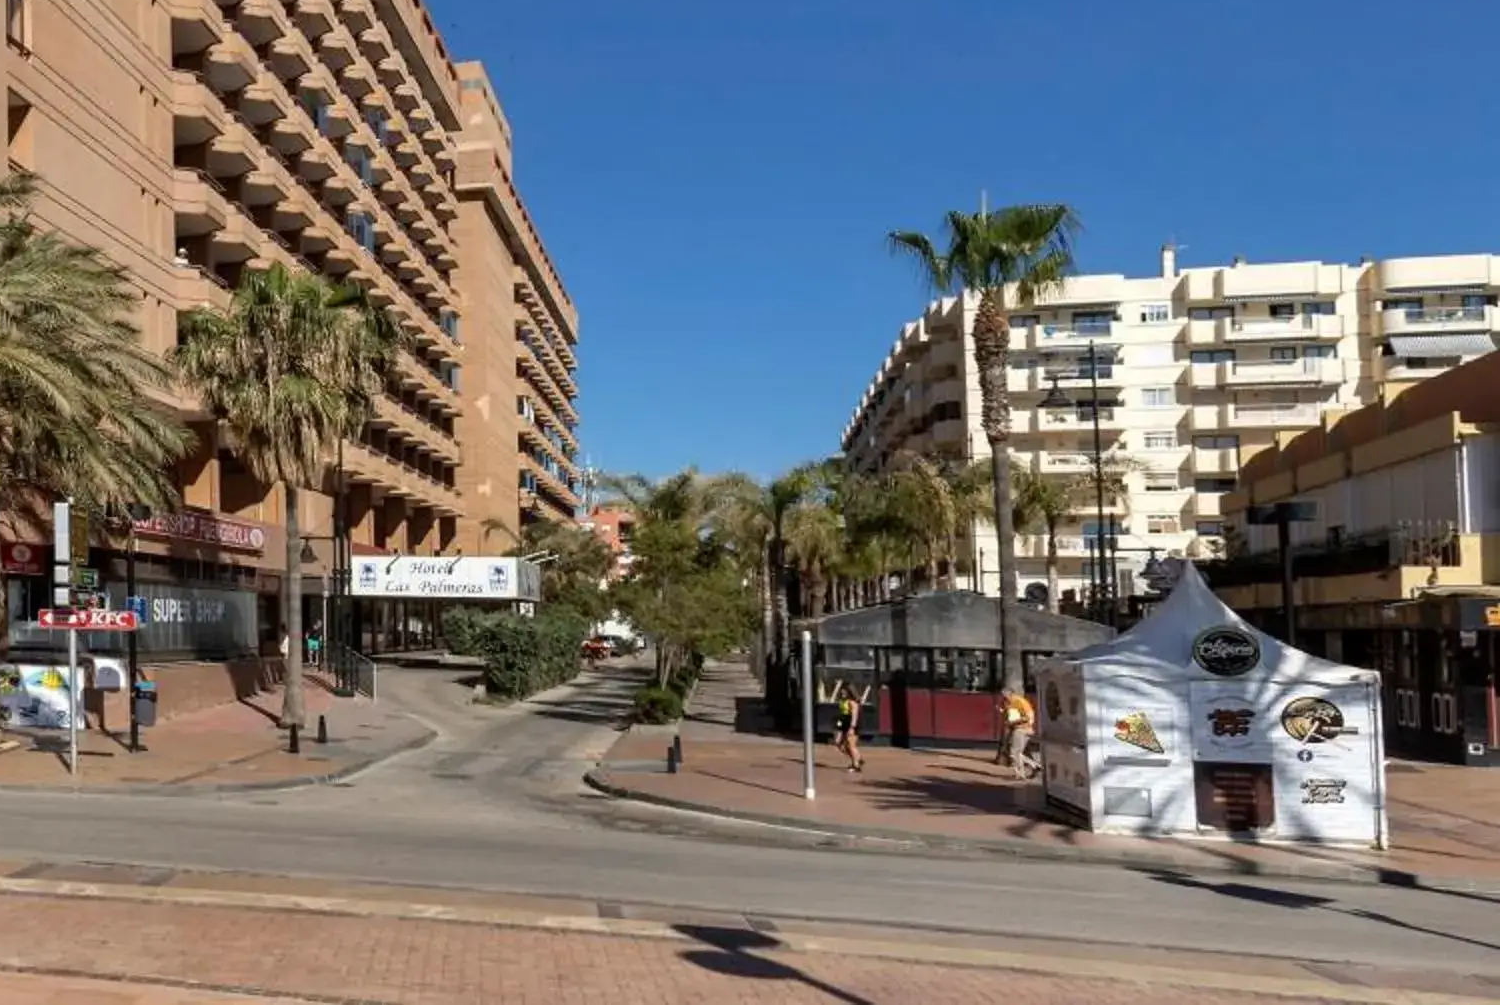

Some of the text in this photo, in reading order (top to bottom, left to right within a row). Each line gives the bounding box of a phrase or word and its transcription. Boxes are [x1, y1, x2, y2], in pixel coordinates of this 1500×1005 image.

[409, 561, 454, 575] Hotel
[385, 580, 411, 593] Las
[418, 578, 484, 594] Palmeras
[153, 598, 192, 623] SUPER
[90, 611, 128, 626] KFC
